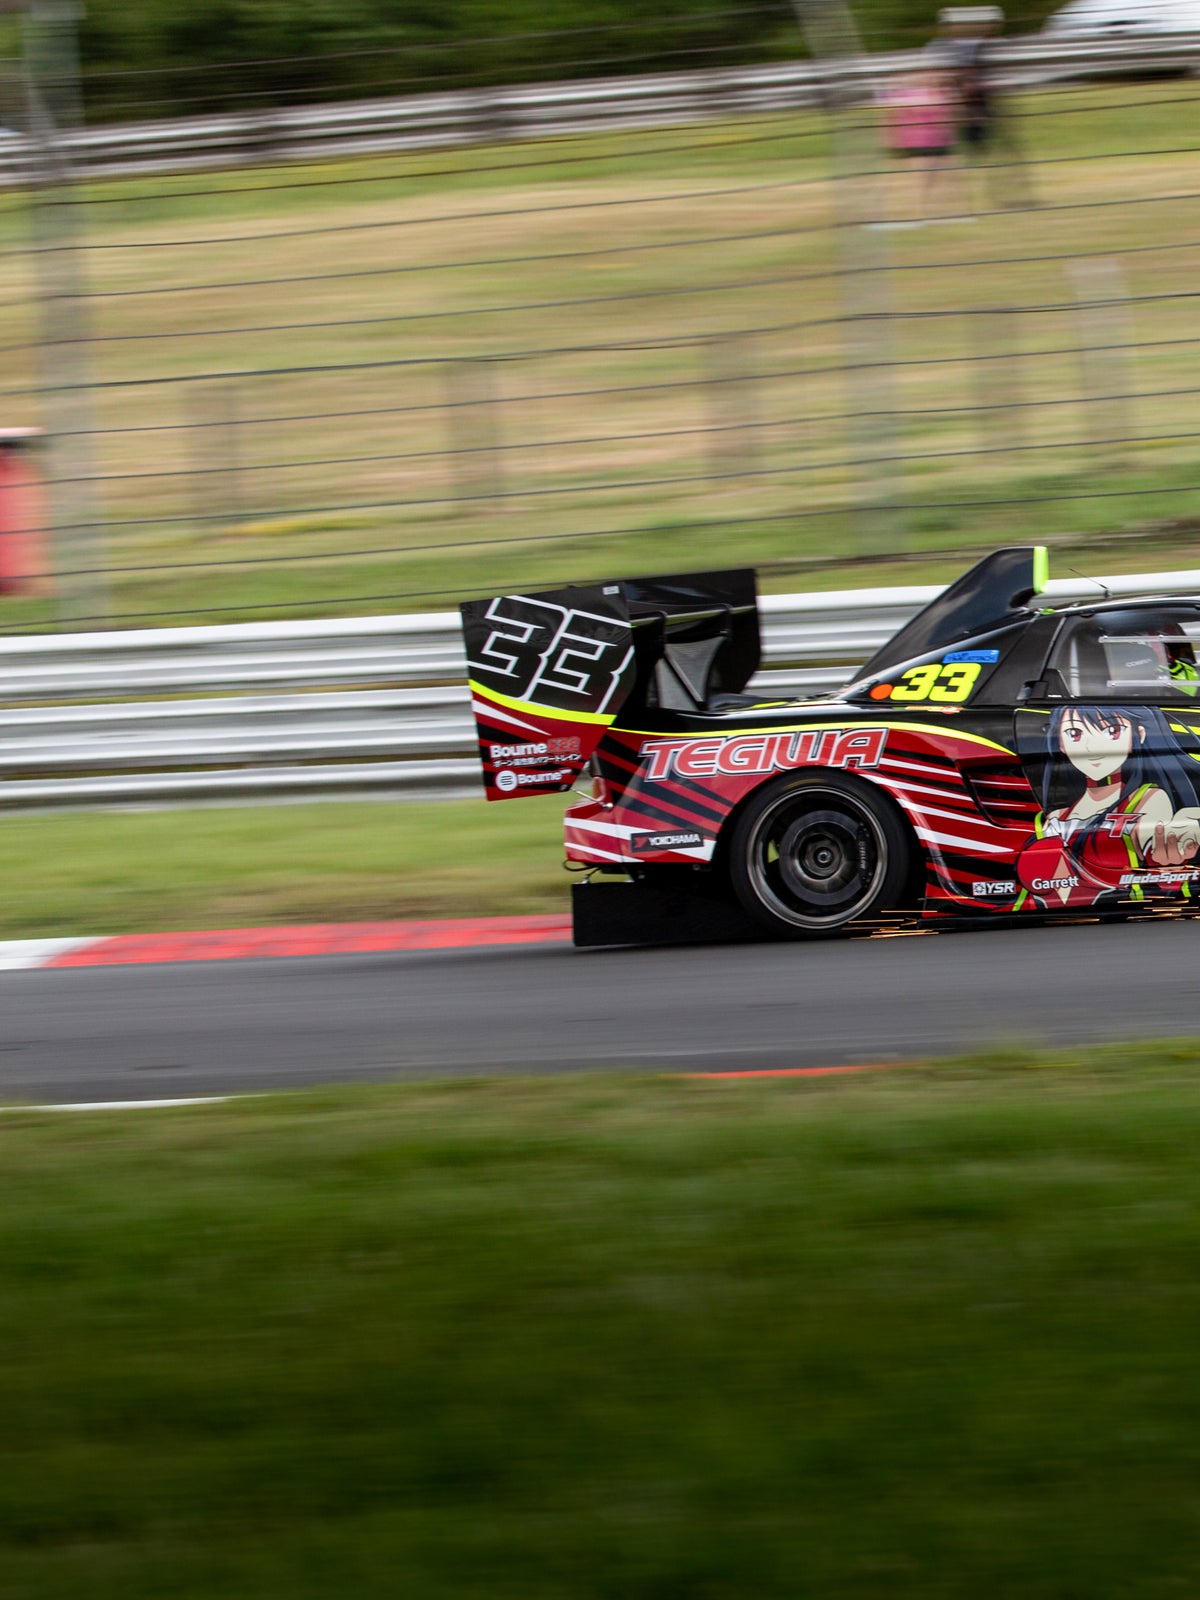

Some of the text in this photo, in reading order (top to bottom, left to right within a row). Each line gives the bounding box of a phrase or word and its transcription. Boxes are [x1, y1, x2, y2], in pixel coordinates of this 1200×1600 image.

[890, 662, 982, 702] 33
[490, 742, 548, 758] Bourne
[641, 728, 888, 782] TEGIWA
[517, 772, 562, 784] Bourne
[648, 833, 701, 846] YOKOHAMA
[1031, 876, 1079, 890] Garrett
[1119, 870, 1200, 885] WedsSport
[986, 882, 1015, 894] YSR
